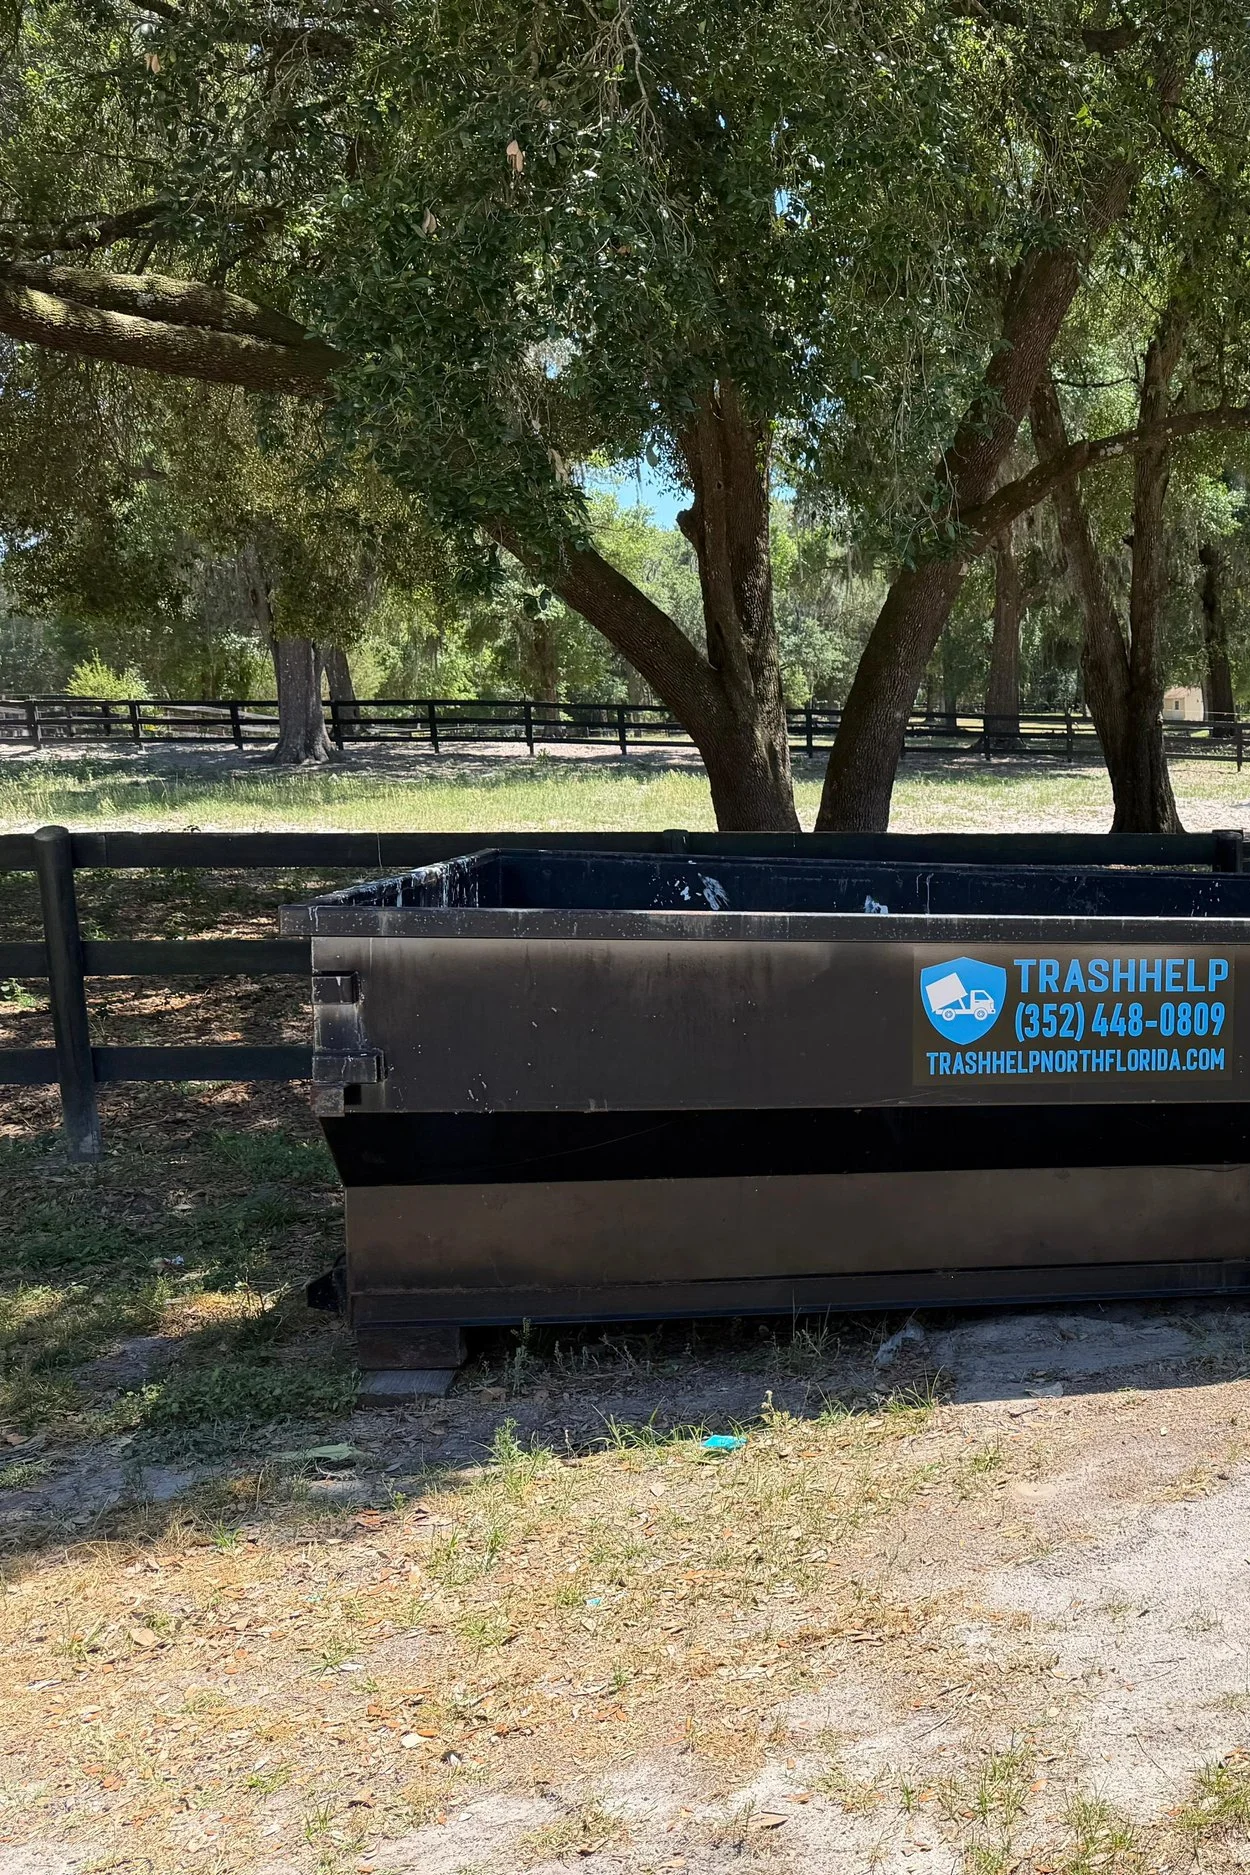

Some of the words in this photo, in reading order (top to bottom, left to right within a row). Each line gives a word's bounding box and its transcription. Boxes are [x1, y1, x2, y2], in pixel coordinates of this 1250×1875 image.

[1013, 958, 1229, 992] TRASHHELP
[1015, 1001, 1085, 1042] (352)
[1091, 1002, 1225, 1037] 448-0809
[926, 1048, 1225, 1075] TRASHHELPNORTHFLORIDA.COM
